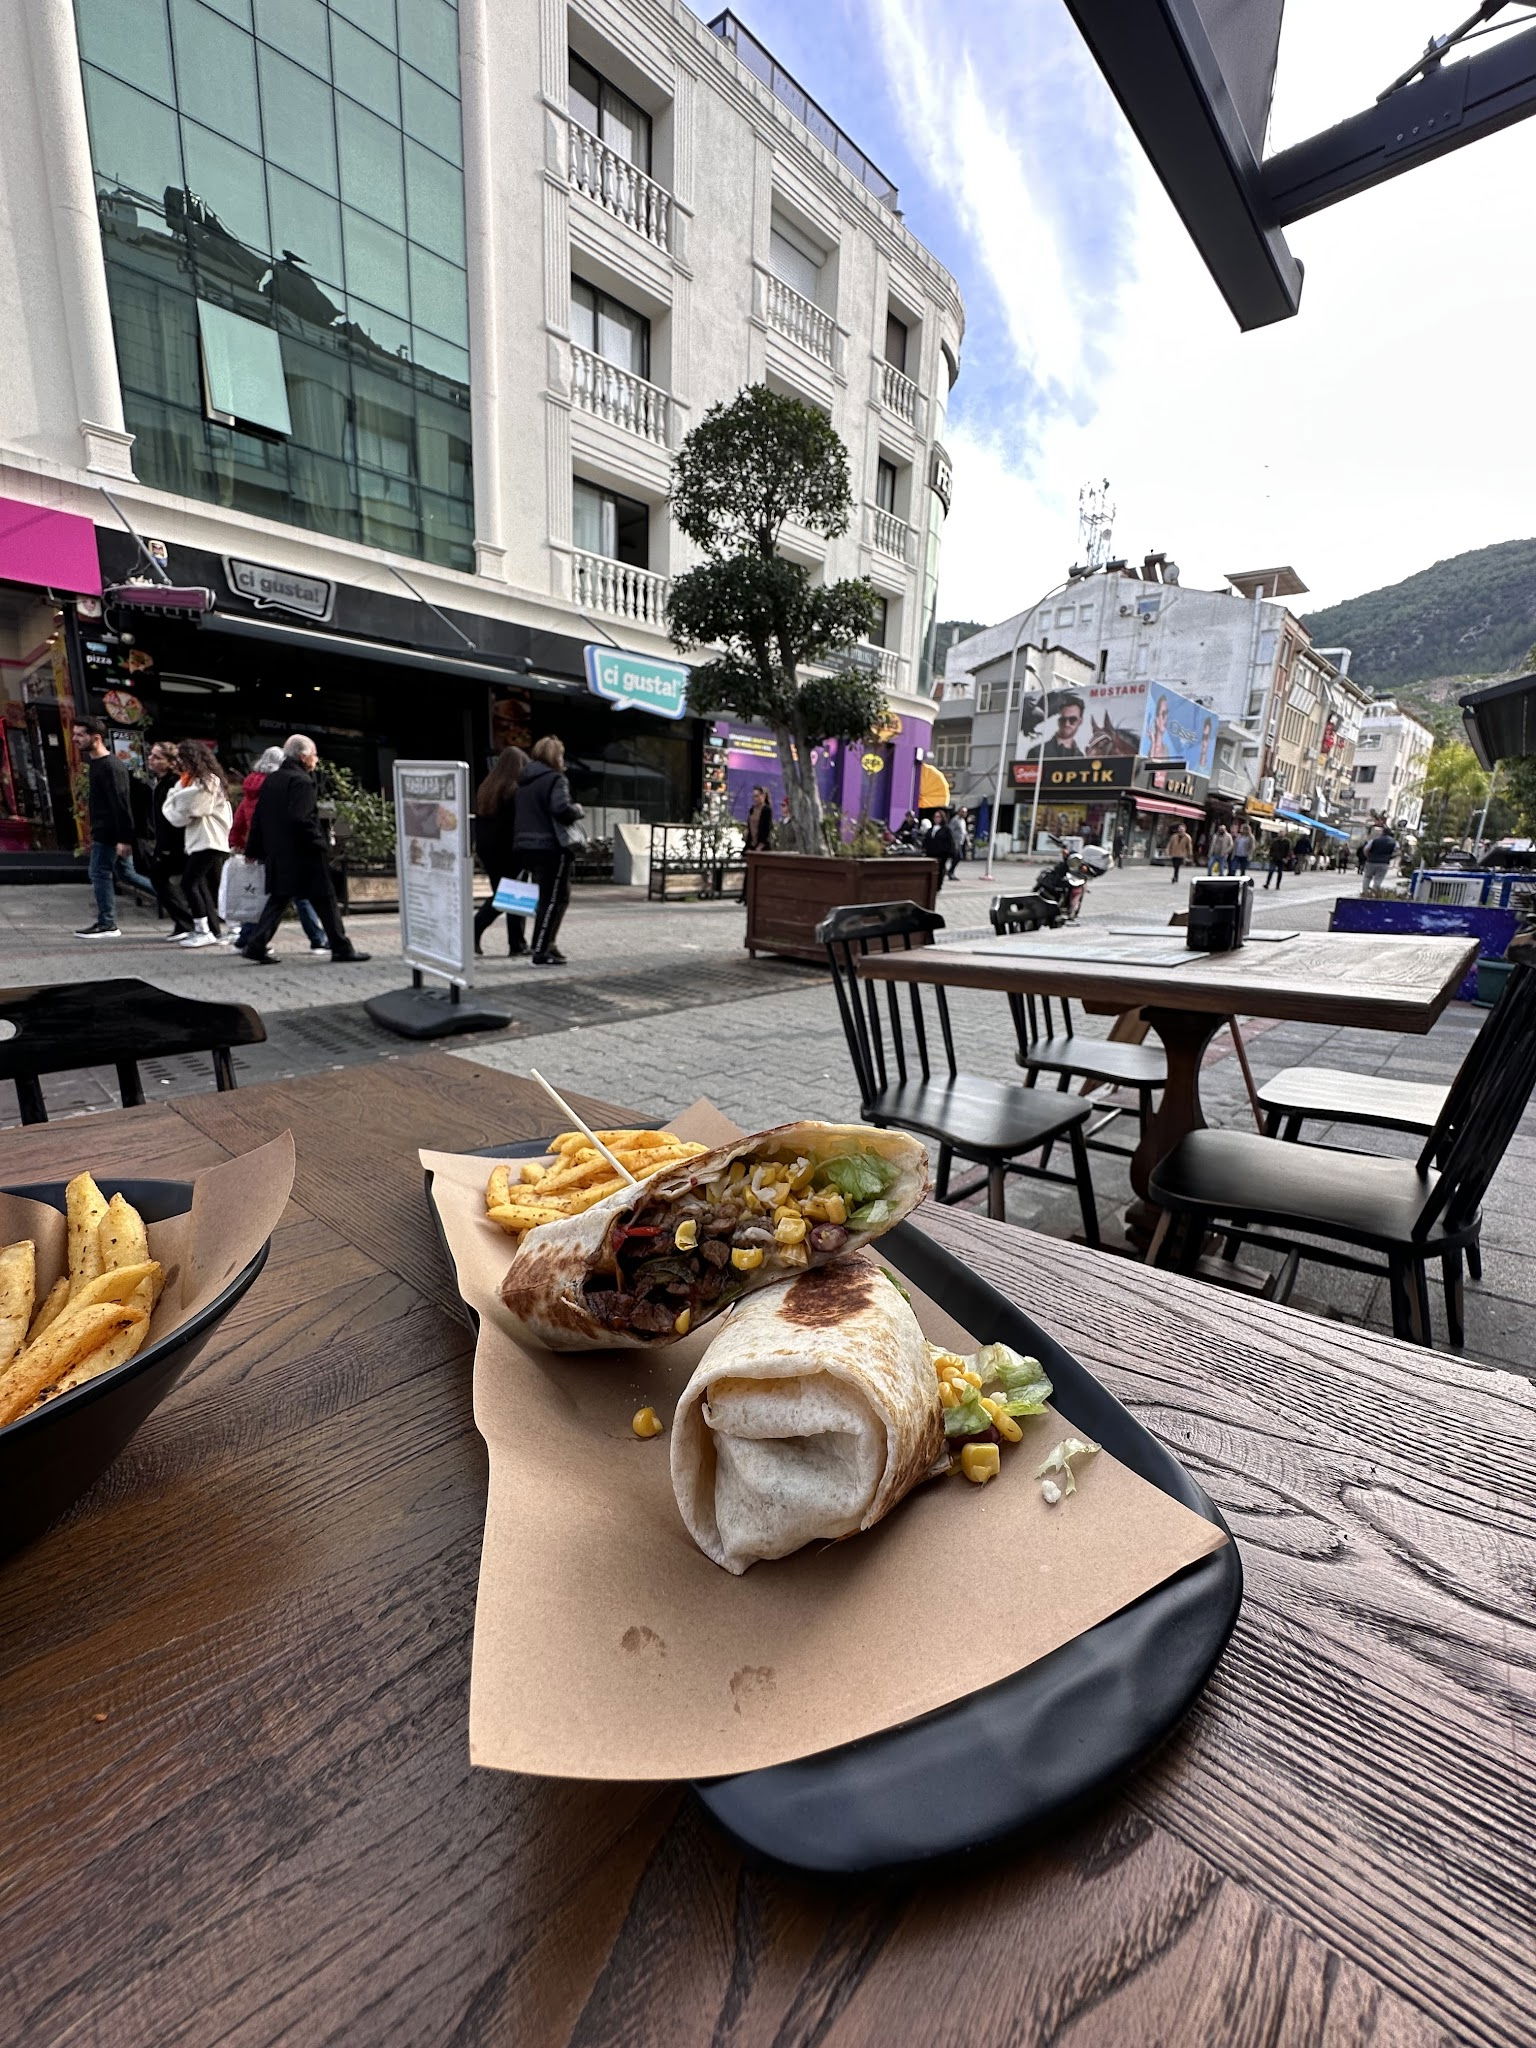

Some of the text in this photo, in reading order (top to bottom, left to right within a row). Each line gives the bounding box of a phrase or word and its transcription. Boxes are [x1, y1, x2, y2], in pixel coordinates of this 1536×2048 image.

[239, 571, 255, 587] ci
[86, 653, 112, 665] pizza
[603, 664, 618, 685] ci
[1090, 684, 1146, 697] MUSTANG
